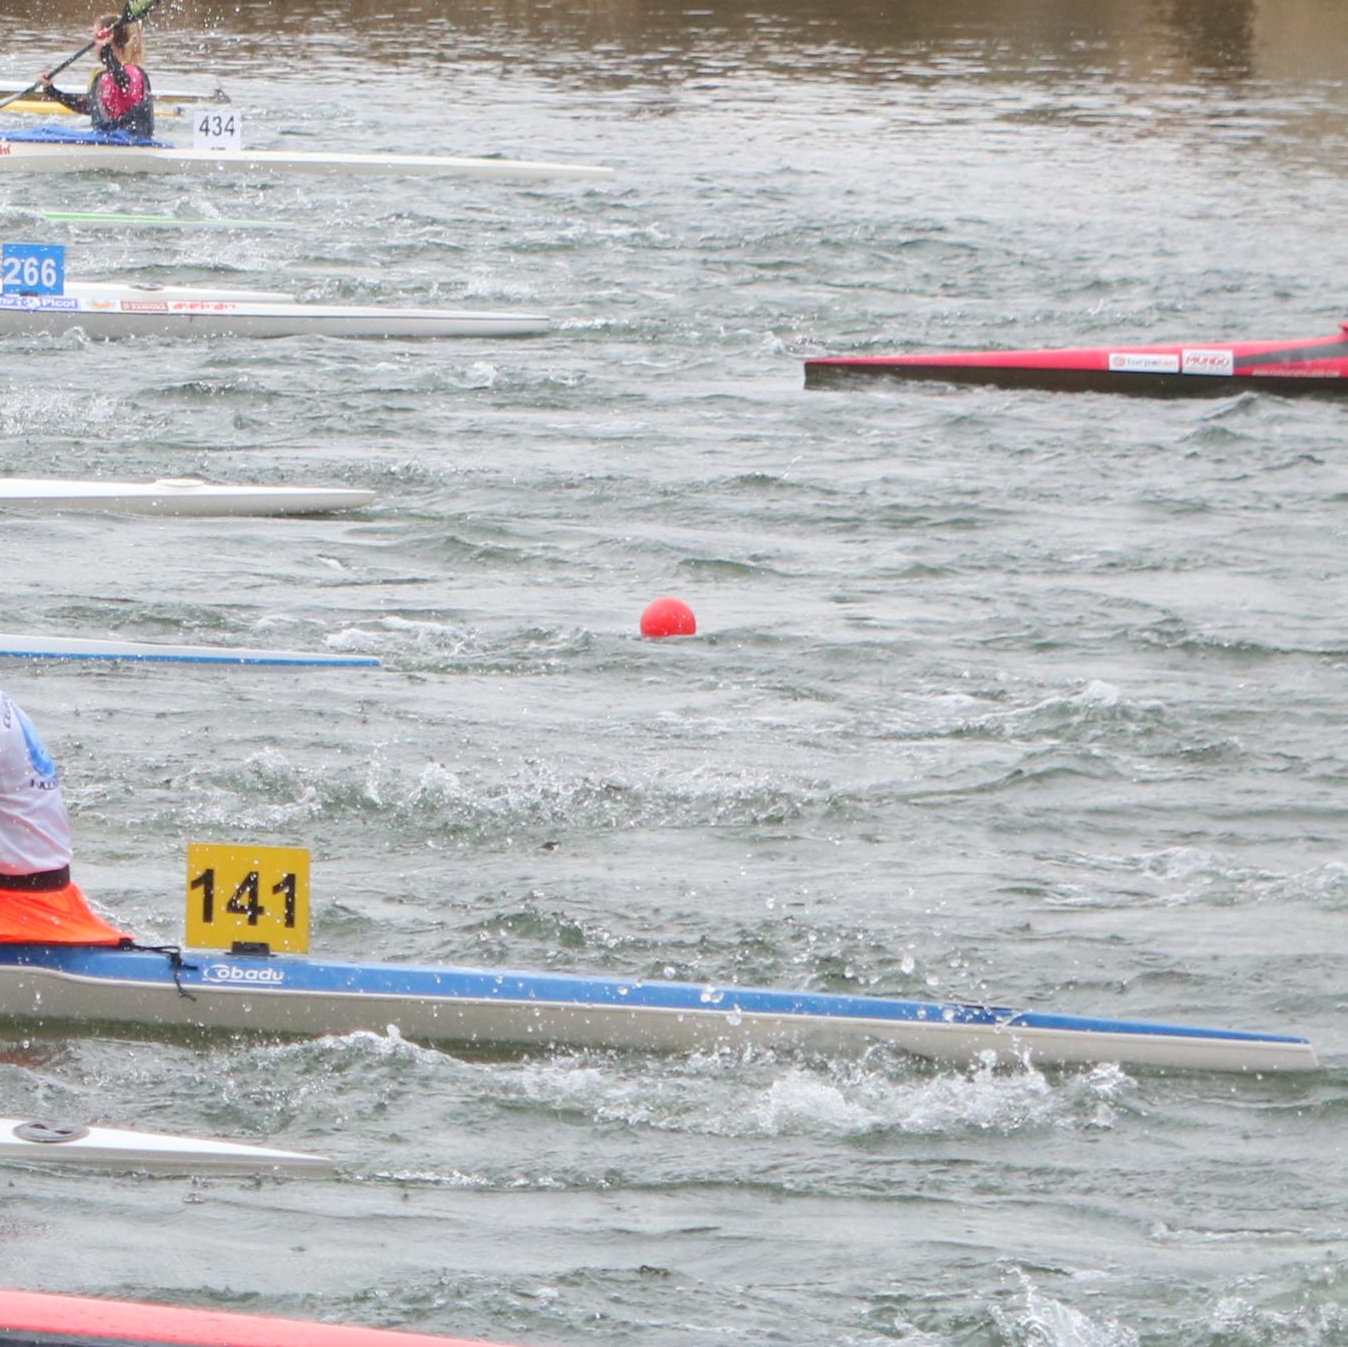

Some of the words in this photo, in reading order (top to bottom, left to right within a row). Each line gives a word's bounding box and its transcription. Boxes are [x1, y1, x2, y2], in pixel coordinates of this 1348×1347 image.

[199, 115, 235, 137] 434
[3, 256, 57, 288] 266
[190, 868, 297, 929] 141
[202, 963, 285, 983] Cobadu
